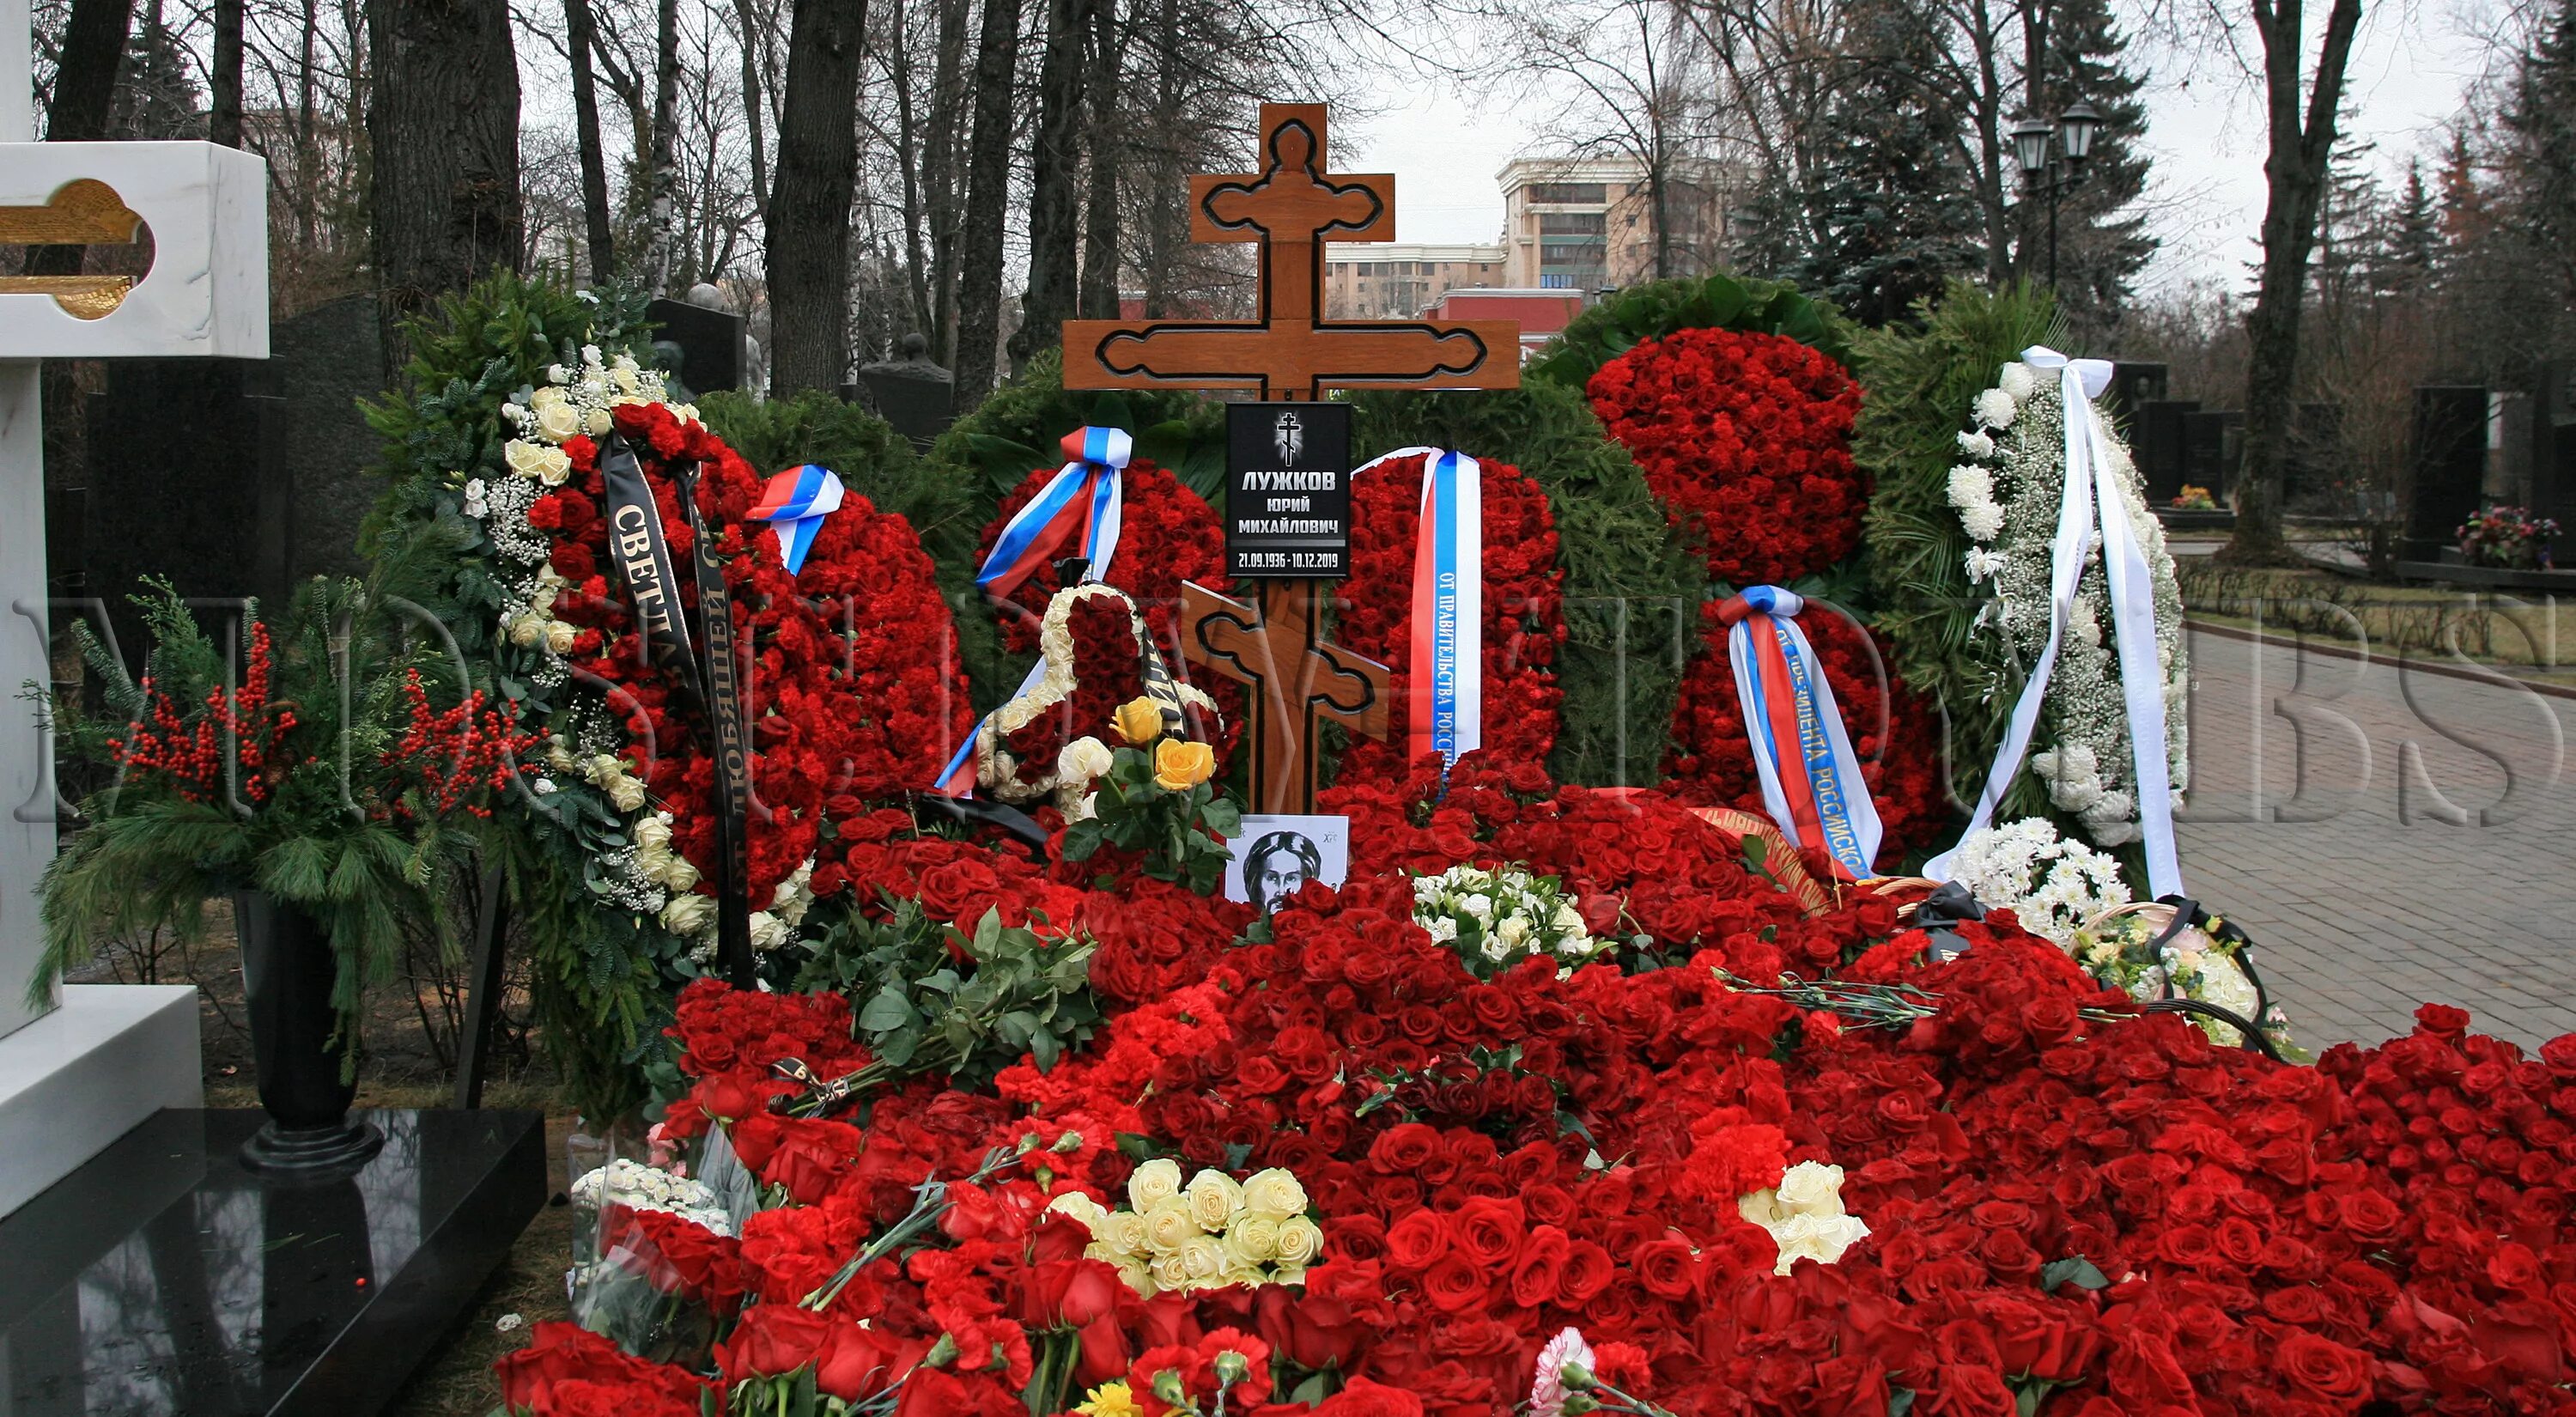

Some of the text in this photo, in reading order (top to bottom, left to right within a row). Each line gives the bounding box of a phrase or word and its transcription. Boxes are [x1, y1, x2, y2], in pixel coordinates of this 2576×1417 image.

[1242, 471, 1336, 490] ЛУЖКОВ
[1267, 496, 1310, 512] ЮРИЙ
[1238, 517, 1339, 533] МИХАЙЛОВИЧ
[1238, 553, 1285, 568] 21.09.1936
[1291, 553, 1338, 568] 10.12.2019
[1439, 572, 1455, 588] ОТ
[1437, 593, 1455, 705] ПРАВИТЕЛЬСТВА
[702, 587, 746, 817] ЛЮБЯЩЕЙ
